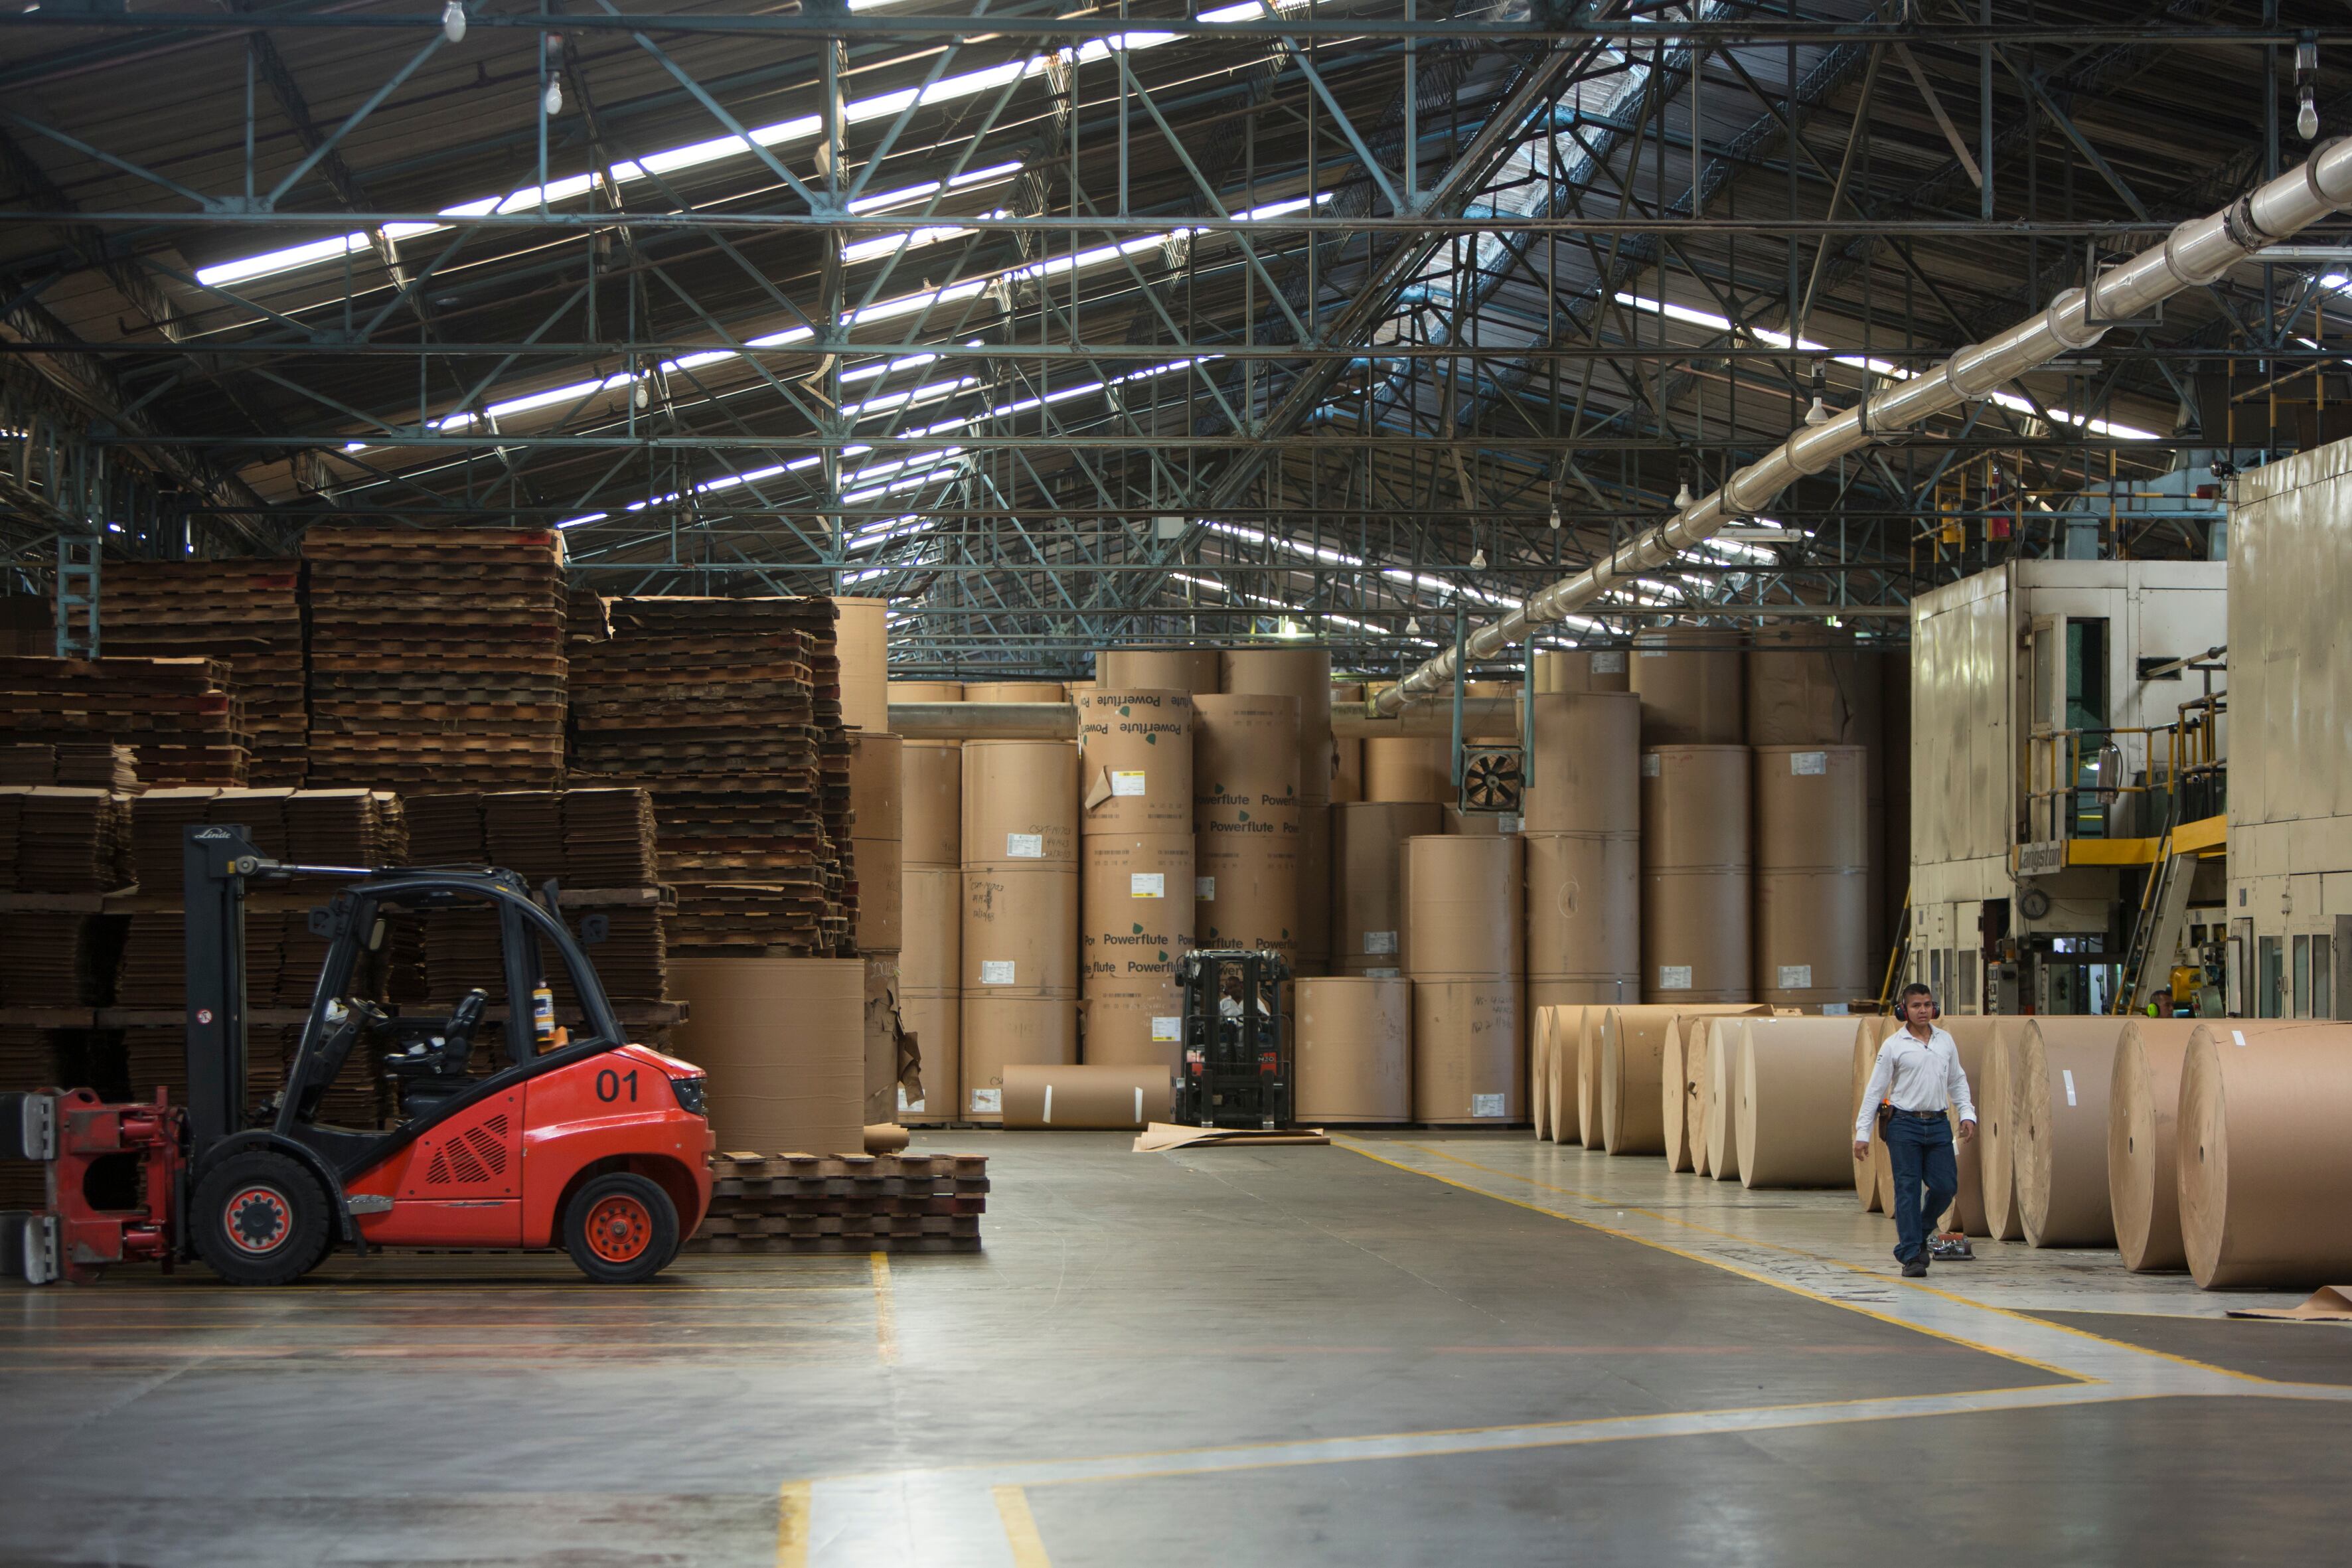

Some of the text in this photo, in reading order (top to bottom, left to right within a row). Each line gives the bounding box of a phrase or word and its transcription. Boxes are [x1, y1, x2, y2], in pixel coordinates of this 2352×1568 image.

[1097, 696, 1160, 707] Powerflute
[1120, 723, 1181, 734] Powerflute
[1210, 821, 1274, 832] Powerflute
[195, 827, 231, 838] Linde
[2018, 843, 2060, 872] Langston
[1104, 934, 1168, 945] Powerflute
[596, 1069, 637, 1103] 01
